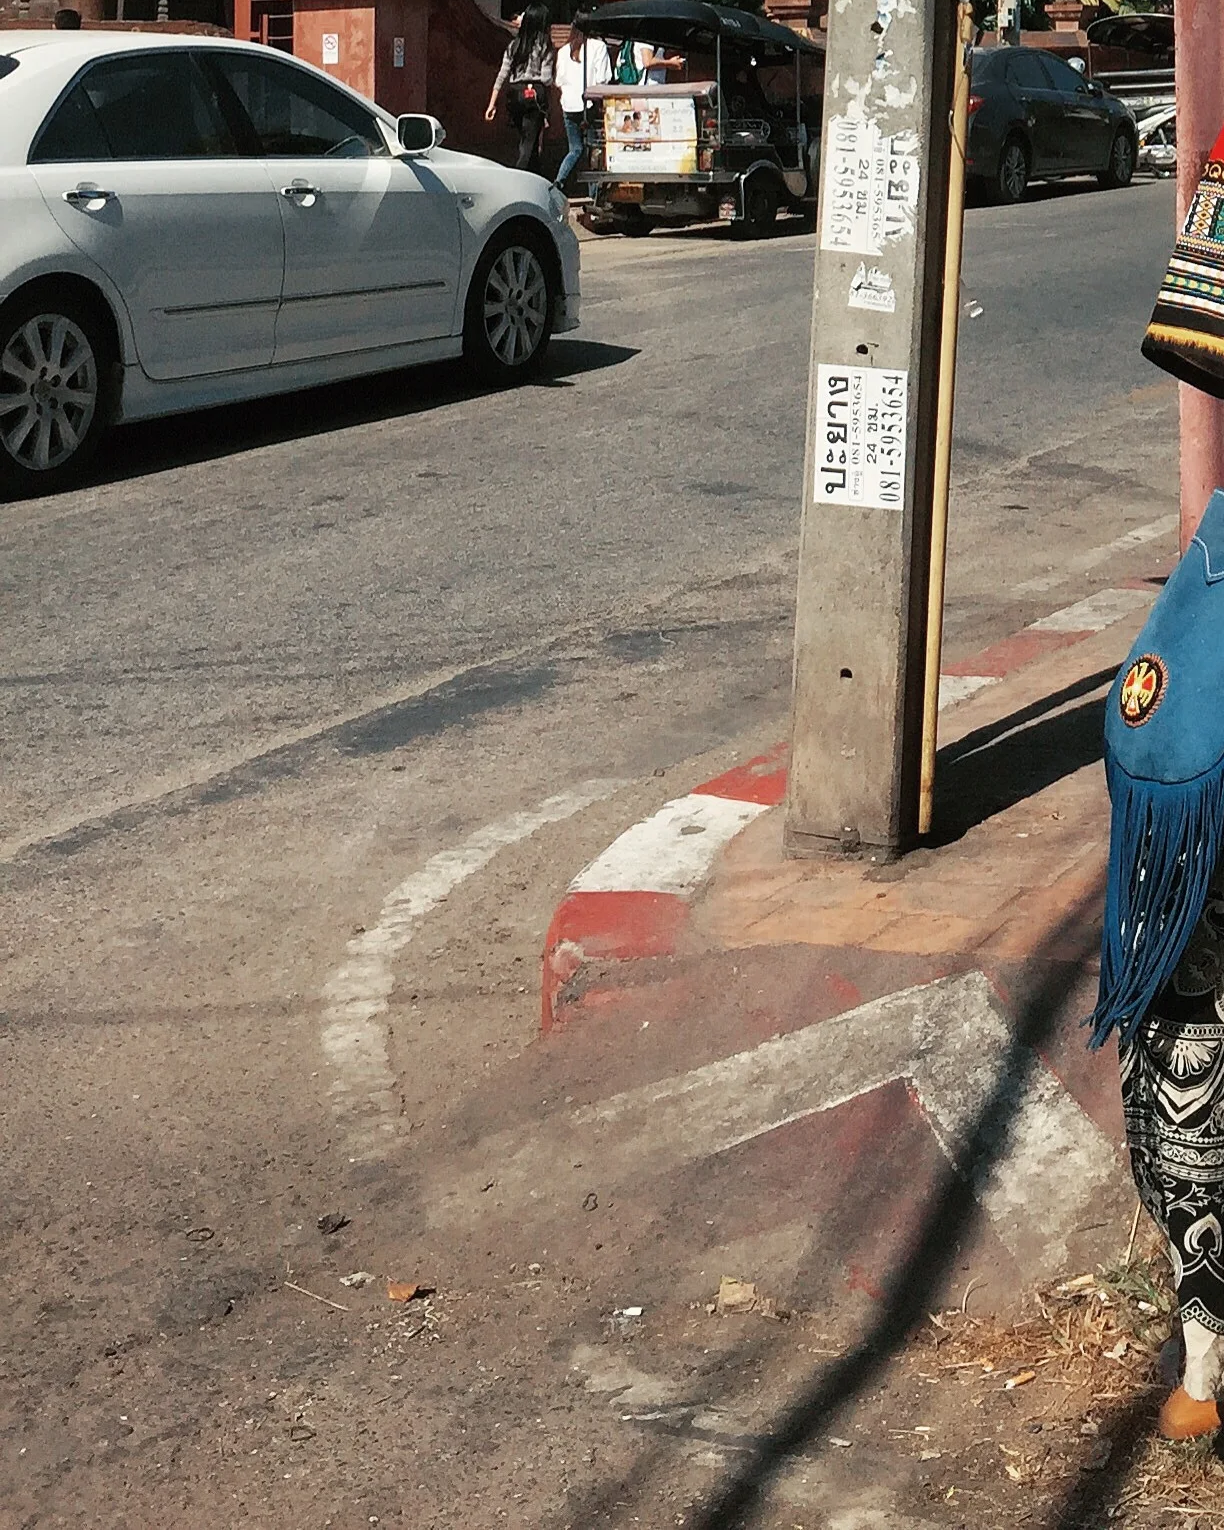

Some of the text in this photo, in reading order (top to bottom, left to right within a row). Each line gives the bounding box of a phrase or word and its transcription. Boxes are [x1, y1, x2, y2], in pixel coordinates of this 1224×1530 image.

[820, 376, 849, 494] ปะยาง
[866, 443, 877, 464] 24
[879, 375, 903, 502] 081-5953654
